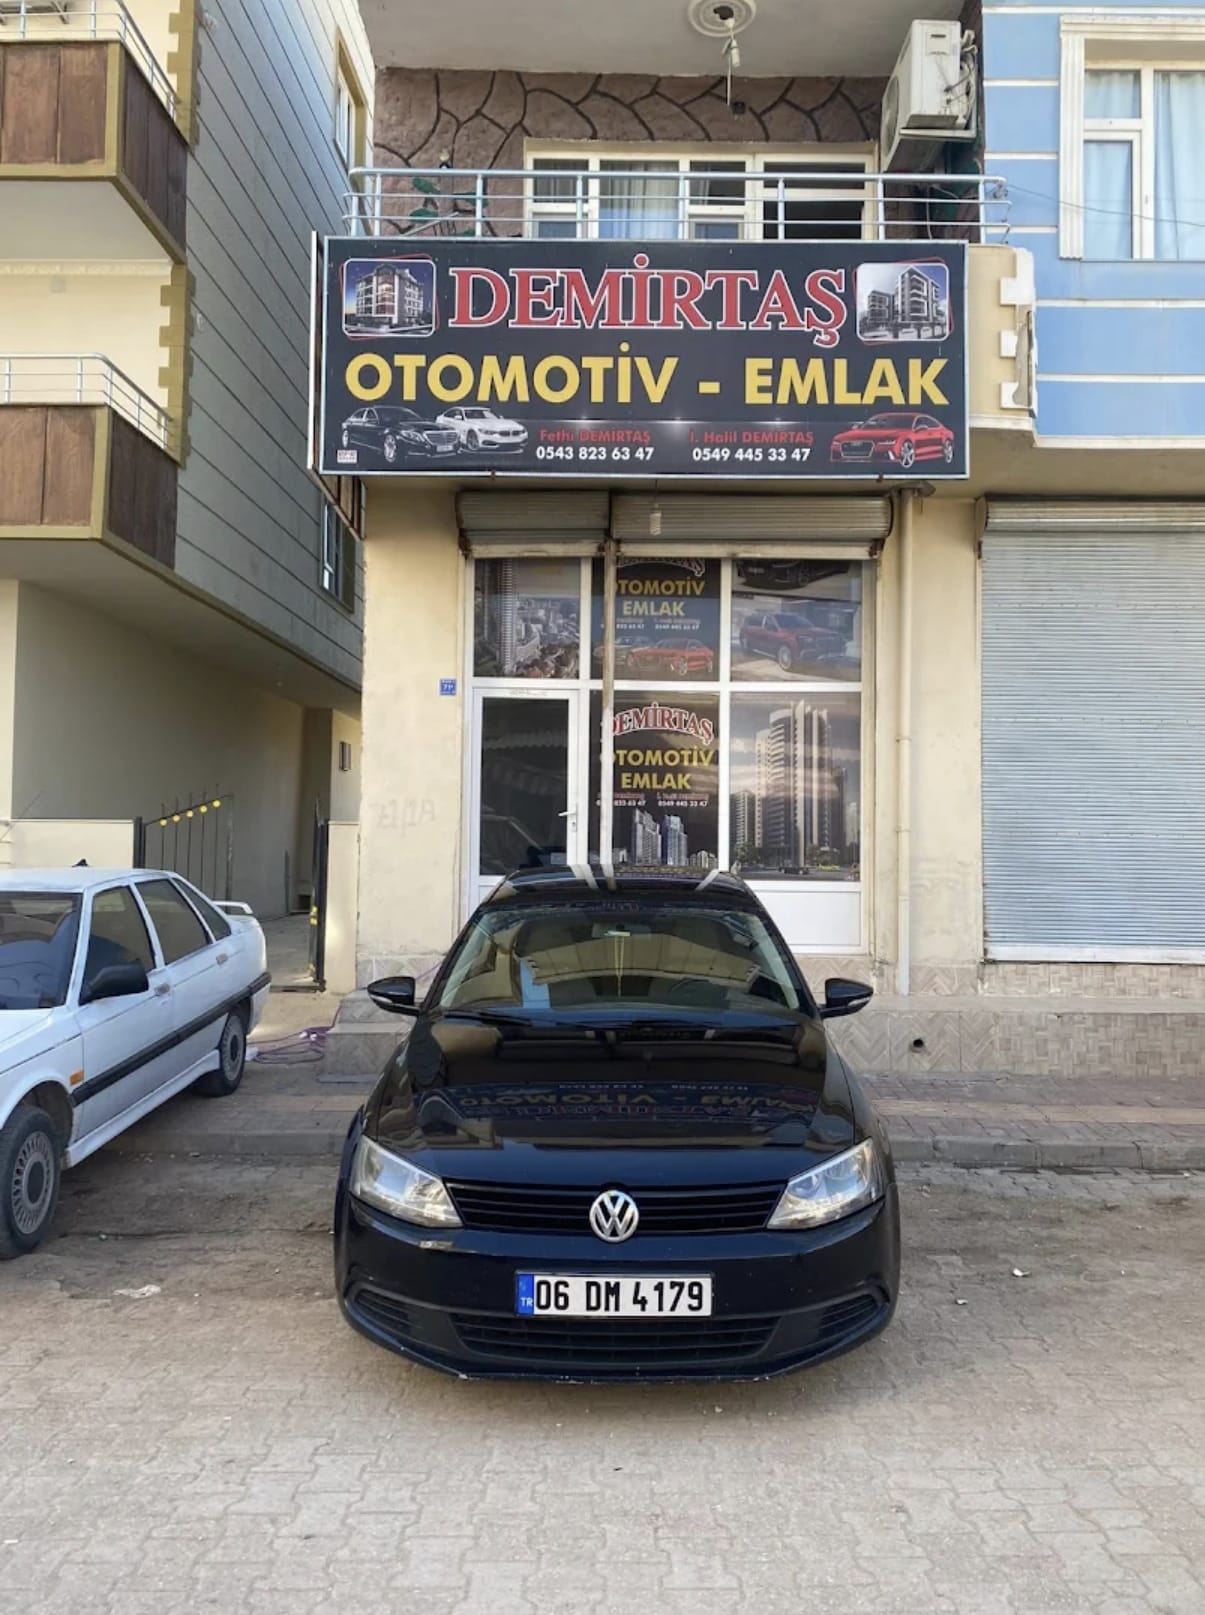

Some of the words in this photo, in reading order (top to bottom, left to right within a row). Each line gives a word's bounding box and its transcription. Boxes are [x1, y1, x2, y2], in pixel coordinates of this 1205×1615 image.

[448, 253, 847, 347] DEMİRTAŞ
[345, 342, 679, 404] OTOMOTİV
[699, 381, 721, 394] -
[744, 357, 948, 406] EMLAK
[540, 428, 574, 442] Fethi
[704, 430, 737, 443] Halil
[536, 446, 574, 460] 0543
[579, 446, 607, 460] 823
[611, 446, 631, 460] 63
[635, 446, 655, 460] 47
[692, 447, 731, 461] 0549
[734, 447, 763, 461] 445
[768, 447, 787, 461] 33
[791, 447, 811, 461] 47
[616, 576, 705, 596] TOMOTİV
[623, 601, 685, 616] EMLAK
[612, 741, 714, 767] TOMOTİV
[621, 773, 691, 790] EMLAK
[520, 1297, 533, 1307] TR
[536, 1280, 569, 1311] 06
[586, 1281, 620, 1312] DM
[633, 1281, 703, 1312] 4179
